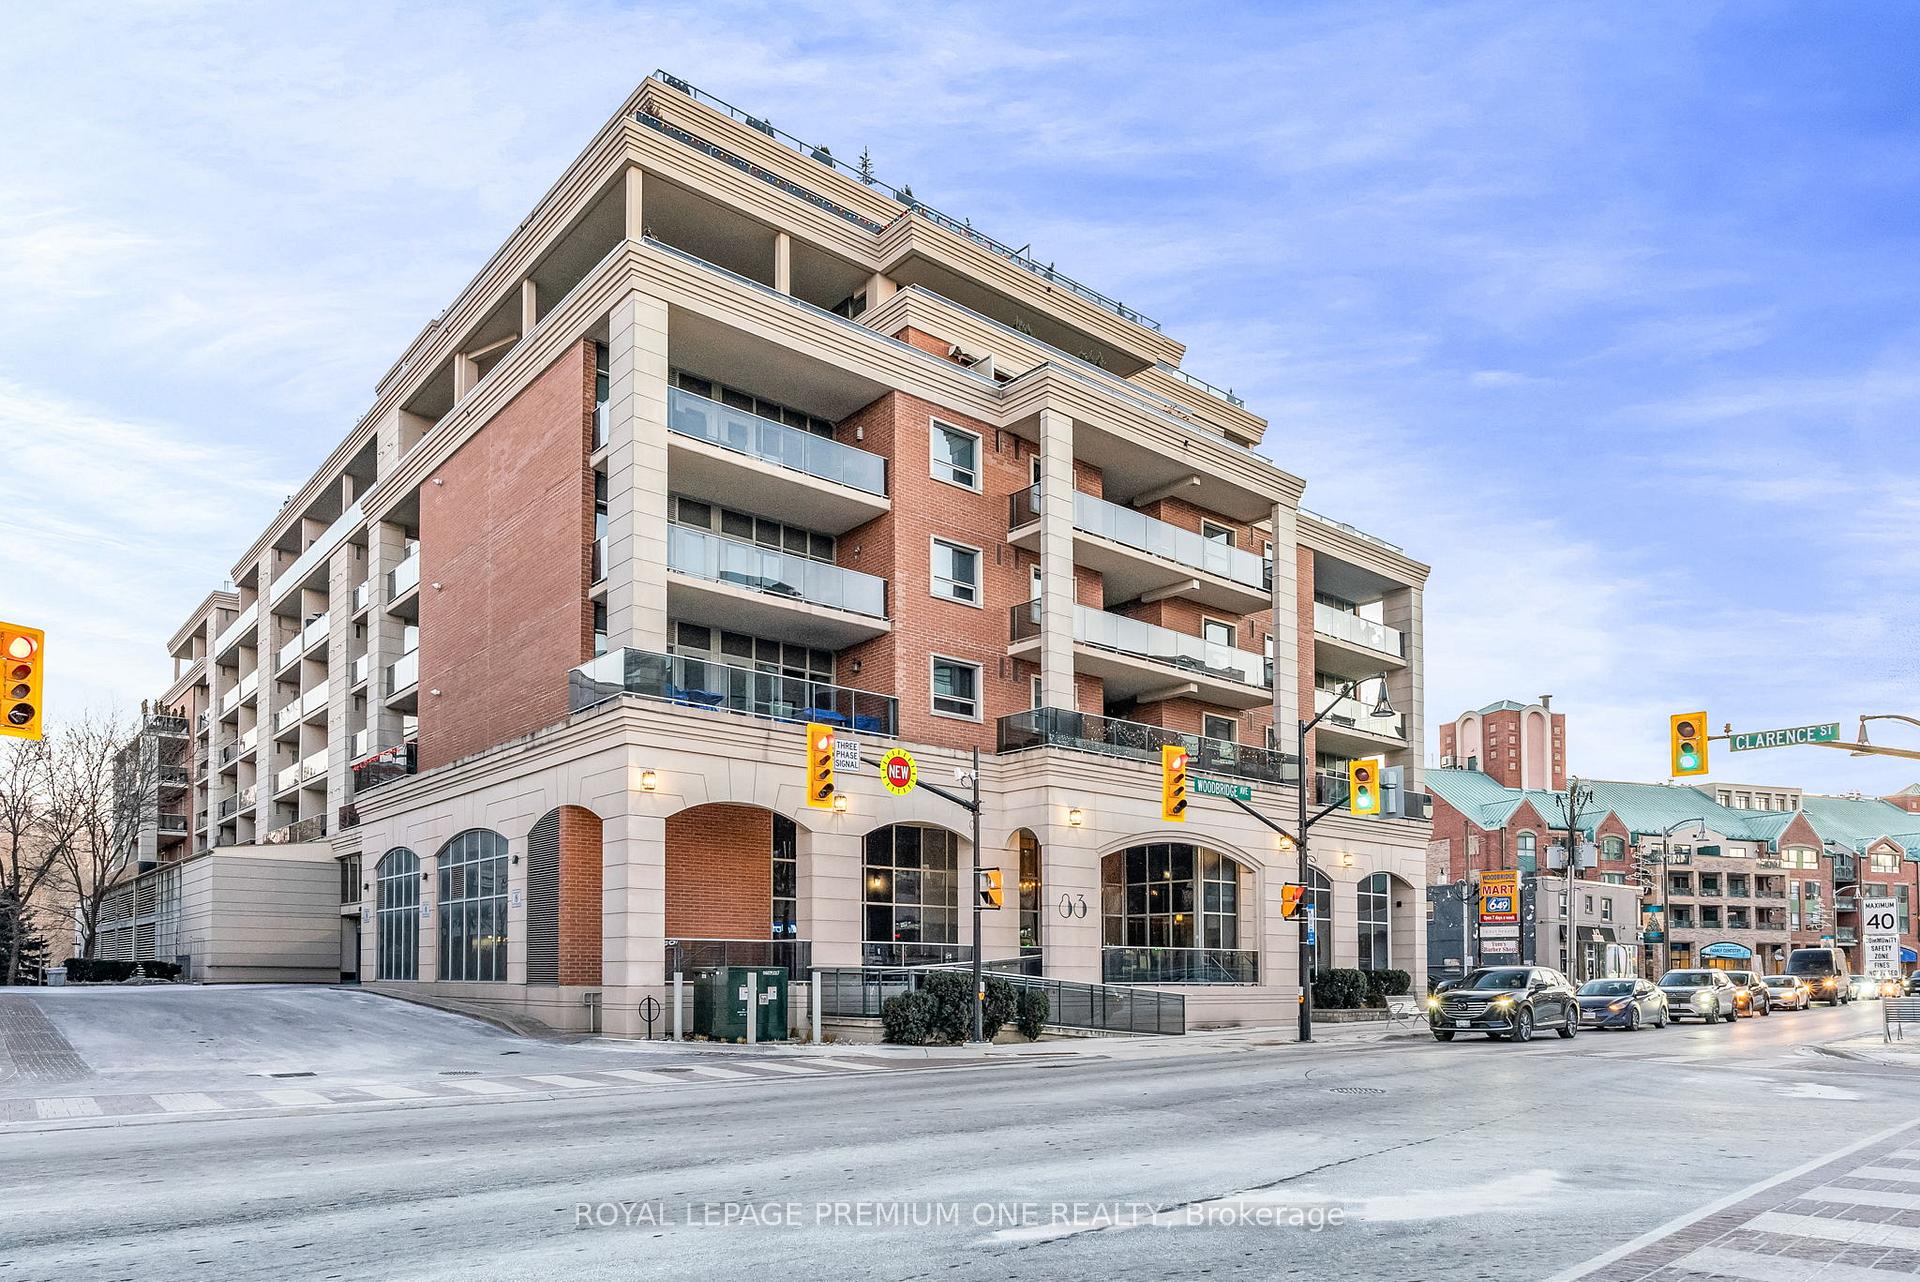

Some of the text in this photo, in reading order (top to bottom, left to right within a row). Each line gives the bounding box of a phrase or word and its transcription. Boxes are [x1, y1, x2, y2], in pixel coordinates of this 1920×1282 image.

[1736, 724, 1834, 750] CLARENCE ST
[837, 741, 857, 751] THREE
[836, 751, 857, 760] PHASE
[835, 760, 858, 769] SIGNAL
[889, 764, 909, 779] NEW
[1197, 780, 1249, 797] WOODBRIDGE AVE
[1483, 885, 1514, 895] MART
[1867, 913, 1894, 929] 40
